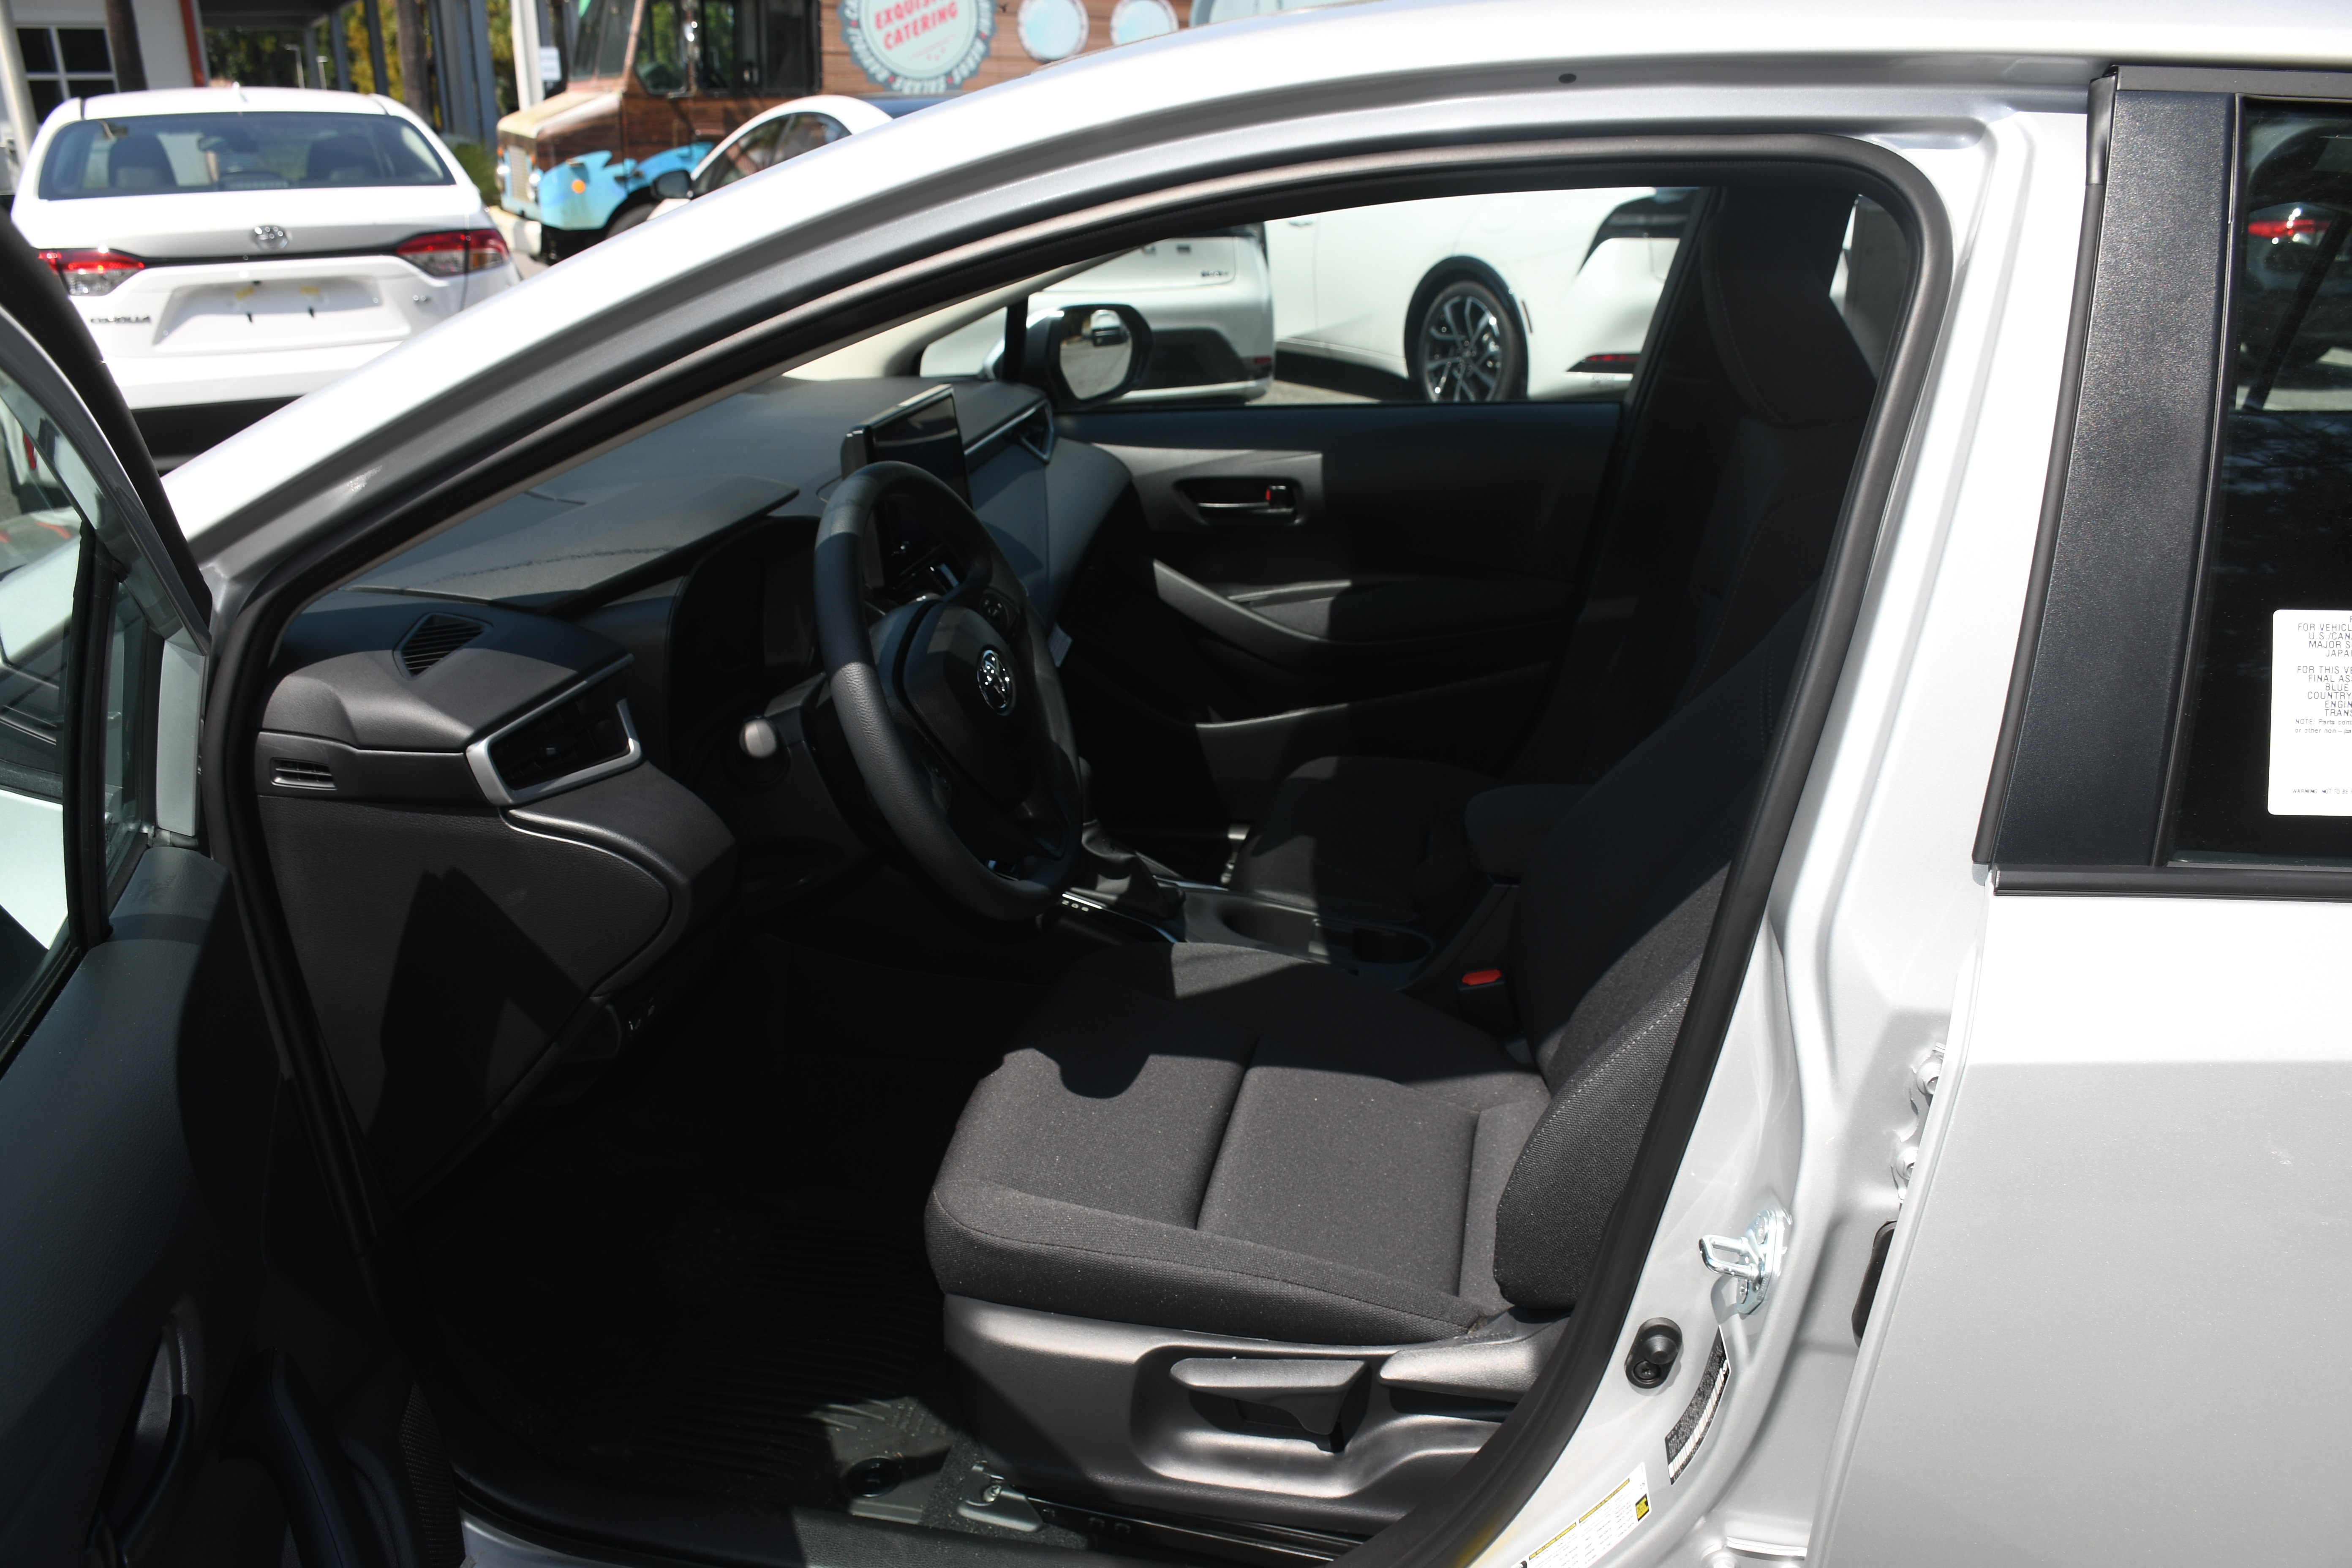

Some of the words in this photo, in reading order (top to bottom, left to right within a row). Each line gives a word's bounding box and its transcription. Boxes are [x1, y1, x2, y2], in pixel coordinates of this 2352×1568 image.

[884, 1, 958, 50] CATERING
[2298, 623, 2315, 631] FOR
[2319, 623, 2352, 632] VEHICL
[2309, 632, 2352, 640] U.S./CAN
[2308, 640, 2341, 648] MAJOR
[2345, 641, 2352, 649] S
[2325, 649, 2352, 657] JAPA
[2297, 666, 2314, 674] FOR
[2319, 666, 2339, 674] THIS
[2338, 675, 2352, 683] AS
[2325, 683, 2349, 691] BLUE
[2307, 691, 2352, 700] COUNTRY
[2325, 700, 2352, 708] ENGIN
